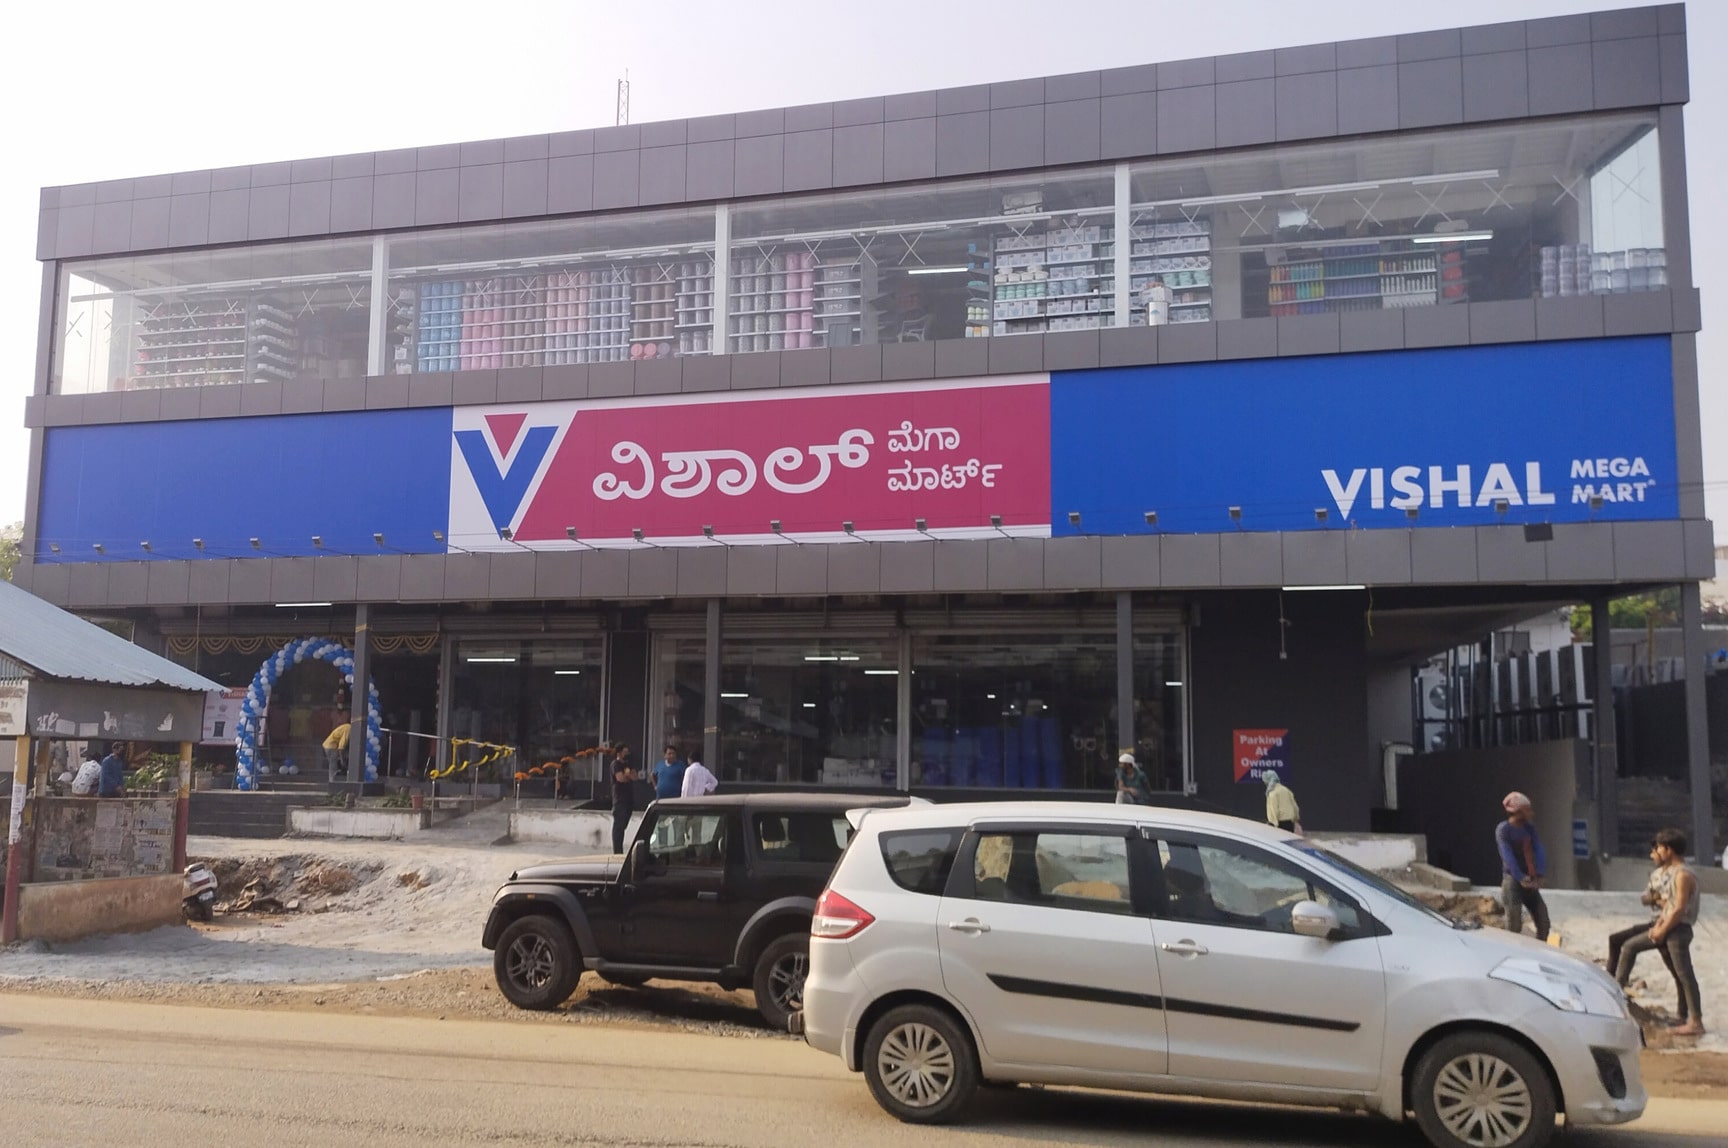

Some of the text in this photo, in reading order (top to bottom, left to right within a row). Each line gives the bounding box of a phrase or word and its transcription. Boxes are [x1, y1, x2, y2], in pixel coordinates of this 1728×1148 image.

[887, 420, 961, 453] ಮೆಗಾ
[592, 428, 875, 501] ವಿಶಾಲ್
[887, 458, 1003, 491] ಮಾರ್ಟ್
[1570, 456, 1651, 479] MEGA
[1321, 461, 1556, 521] VISHAL
[1239, 735, 1283, 746] Parking
[1255, 747, 1268, 756] At
[1240, 757, 1284, 767] Owners
